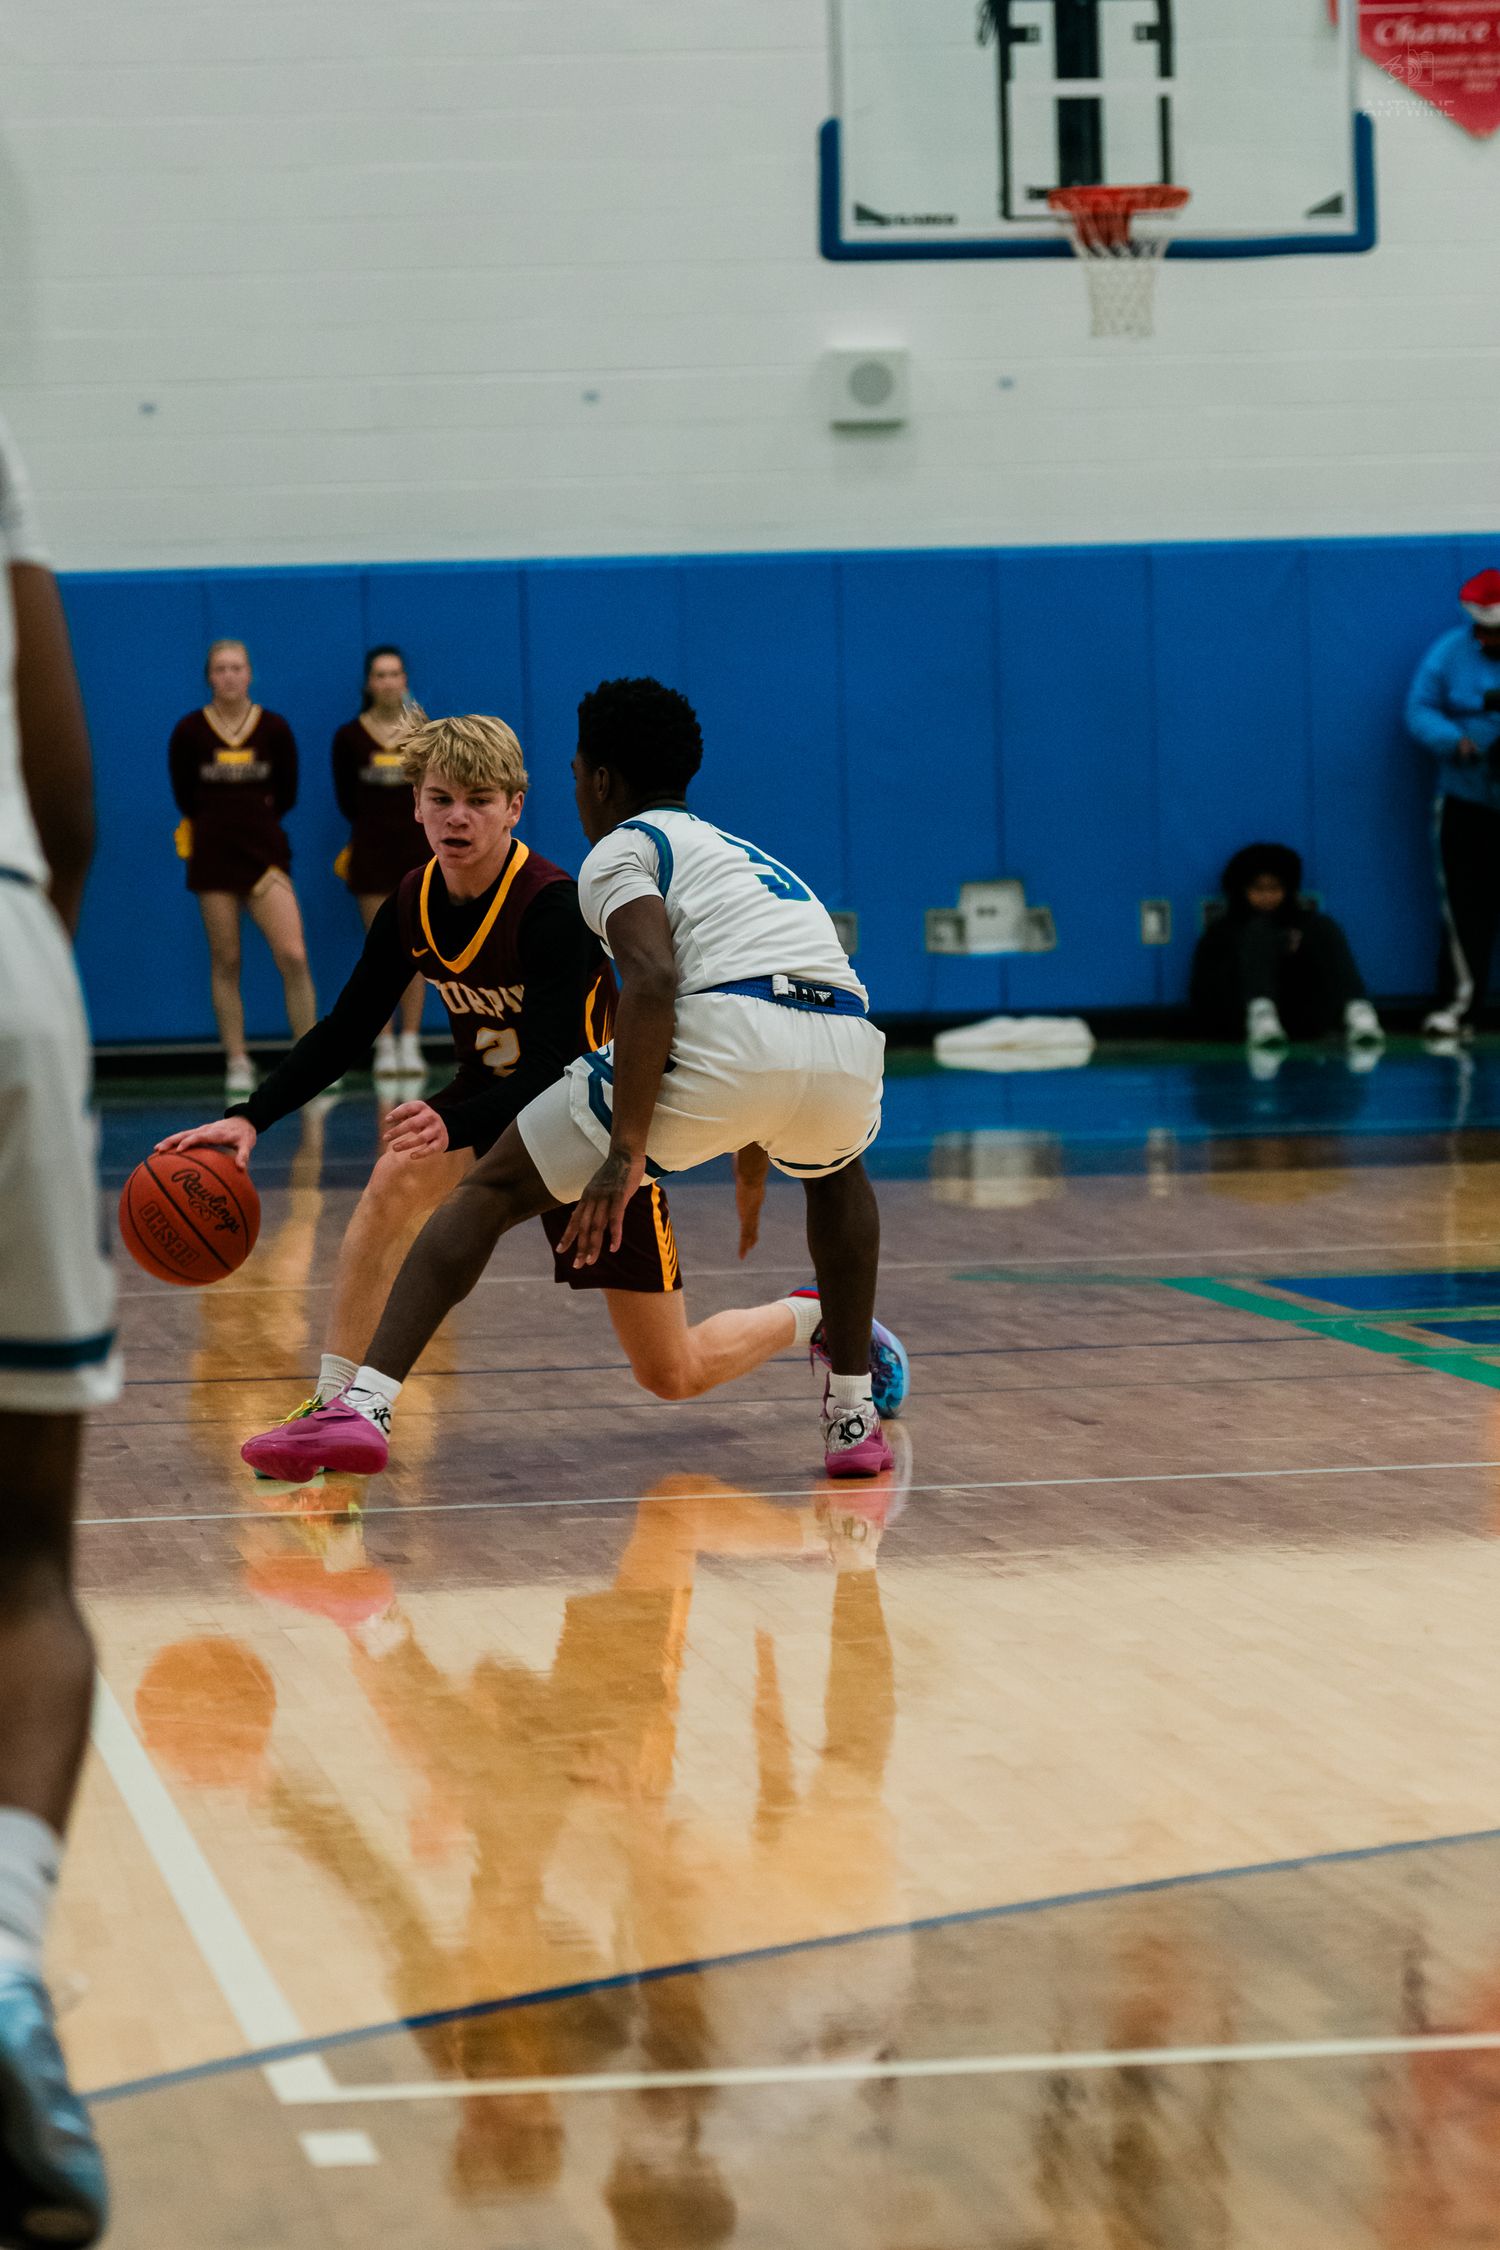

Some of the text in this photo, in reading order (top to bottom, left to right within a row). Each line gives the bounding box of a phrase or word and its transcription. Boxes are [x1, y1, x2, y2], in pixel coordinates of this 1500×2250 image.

[1374, 15, 1491, 47] Chance
[475, 1027, 521, 1078] 2
[171, 1168, 241, 1234] Rawlings
